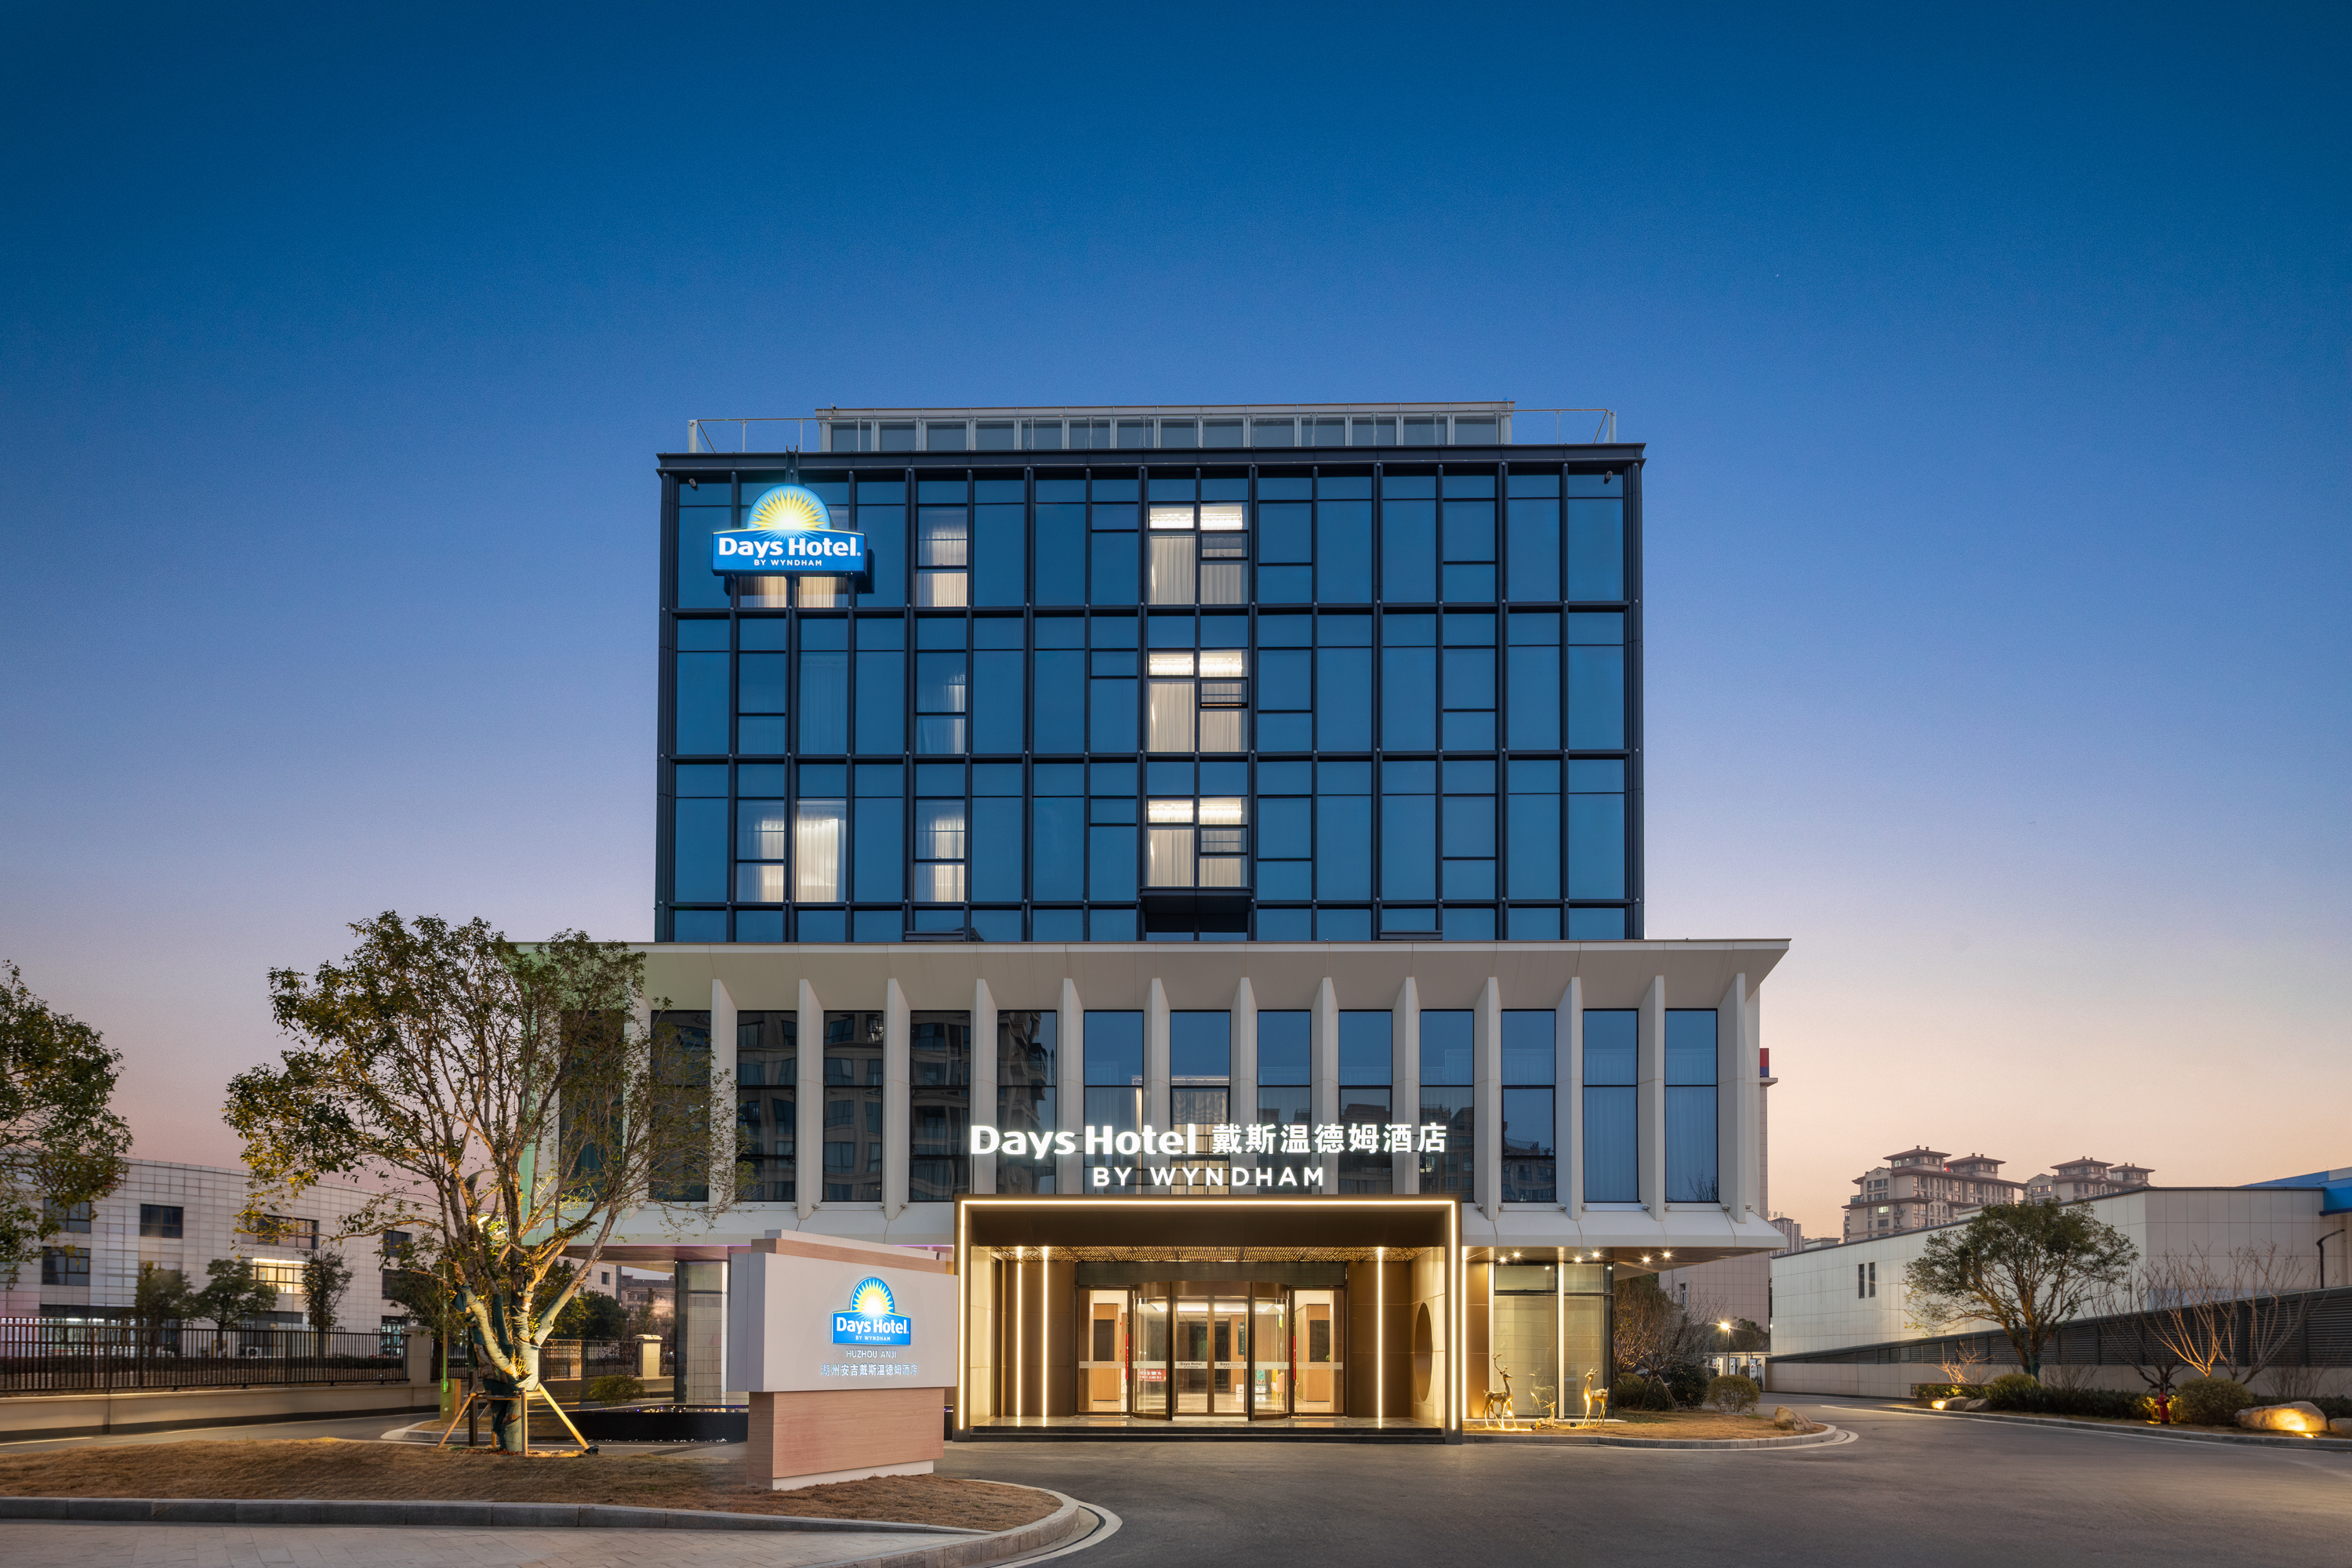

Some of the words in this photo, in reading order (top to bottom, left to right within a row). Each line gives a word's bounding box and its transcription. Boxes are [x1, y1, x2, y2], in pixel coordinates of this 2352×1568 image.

[719, 537, 783, 558] Days
[789, 537, 857, 557] Hotel
[970, 1125, 1075, 1160] Days
[1085, 1123, 1196, 1155] Hotel
[1211, 1122, 1447, 1155] 戴斯温德姆酒店
[1094, 1167, 1132, 1186] BY
[1151, 1167, 1323, 1186] WYNDHAM
[837, 1316, 871, 1334] Days
[873, 1319, 907, 1334] Hotel
[846, 1349, 878, 1359] HUZHOU
[880, 1350, 897, 1359] ANJI
[821, 1363, 918, 1376] 湖州安吉戴斯温德姆酒店
